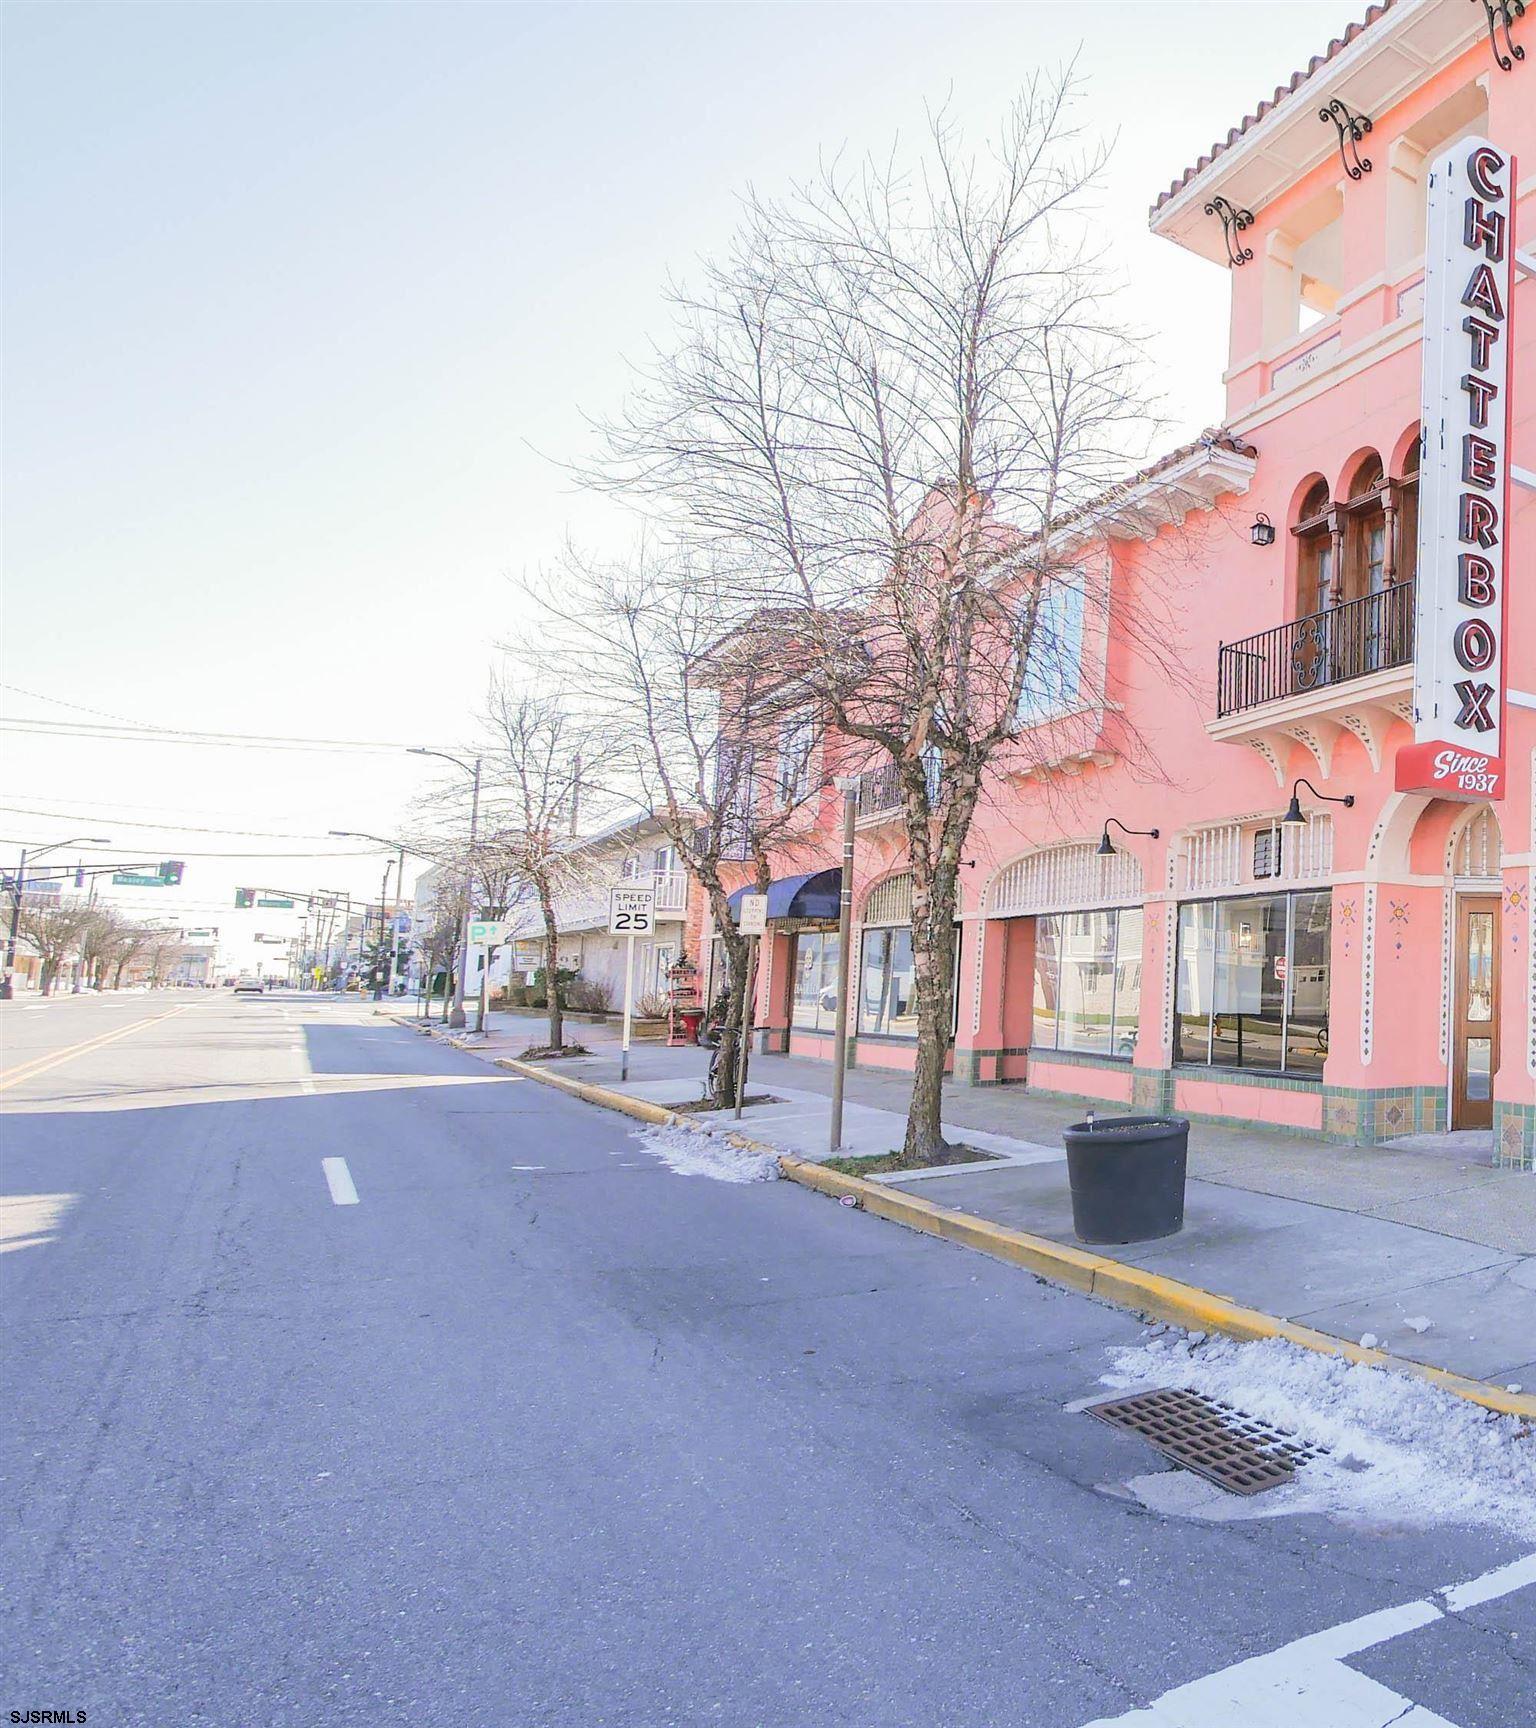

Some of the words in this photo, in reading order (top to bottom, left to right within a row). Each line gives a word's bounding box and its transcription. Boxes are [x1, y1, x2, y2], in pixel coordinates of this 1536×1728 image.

[1453, 147, 1505, 733] CHATTERBOX
[1433, 750, 1488, 779] Since
[1457, 773, 1499, 793] 1937
[615, 893, 652, 902] SPEED
[618, 903, 648, 911] LIMIT
[615, 913, 649, 930] 25
[471, 925, 486, 942] P
